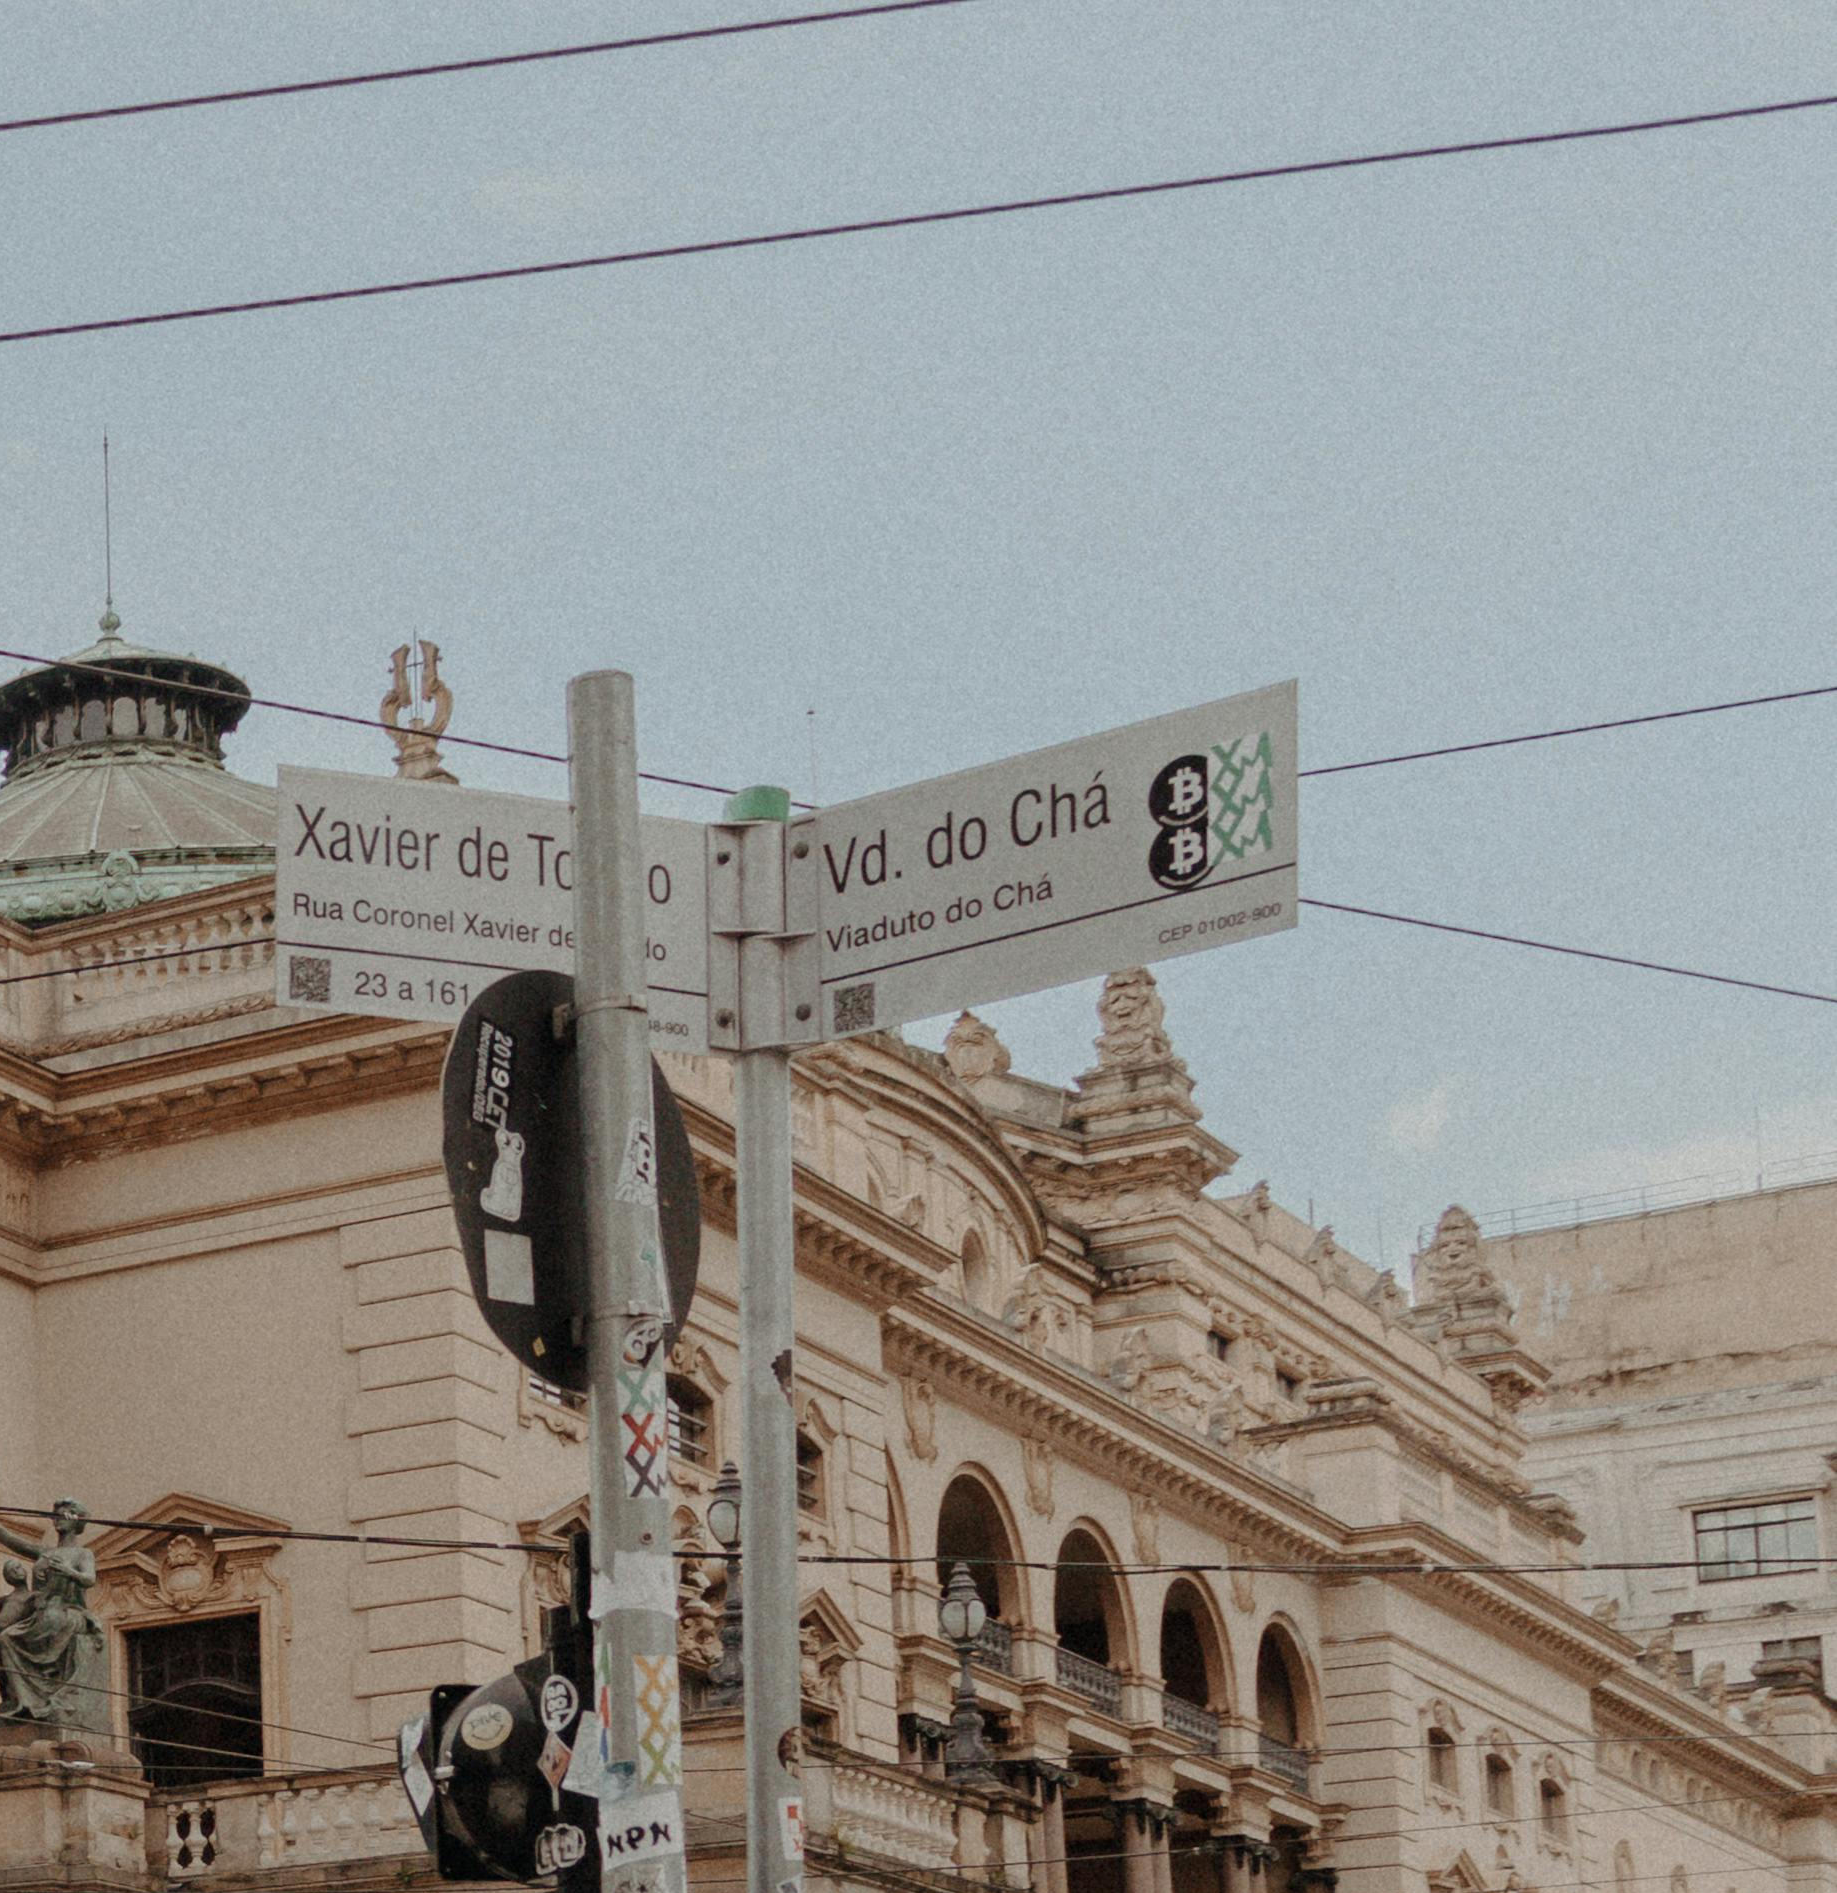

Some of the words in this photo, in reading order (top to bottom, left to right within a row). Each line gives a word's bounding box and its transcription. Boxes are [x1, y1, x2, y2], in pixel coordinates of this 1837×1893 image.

[294, 804, 440, 872] Xavier
[458, 827, 509, 881] de
[823, 829, 903, 895] Vd.
[926, 811, 987, 870] do
[1009, 769, 1111, 847] Chá
[293, 893, 343, 921] Rua
[353, 899, 453, 933] Coronel
[463, 912, 540, 944] Xavier
[549, 927, 574, 949] de
[826, 908, 935, 953] Viaduto
[946, 896, 983, 924] do
[994, 873, 1053, 912] Chá
[1158, 922, 1193, 945] CEP
[1197, 902, 1282, 936] 01002-900
[354, 972, 388, 998] 23
[398, 978, 414, 1000] a
[426, 979, 469, 1007] 161
[490, 1030, 513, 1089] 2019
